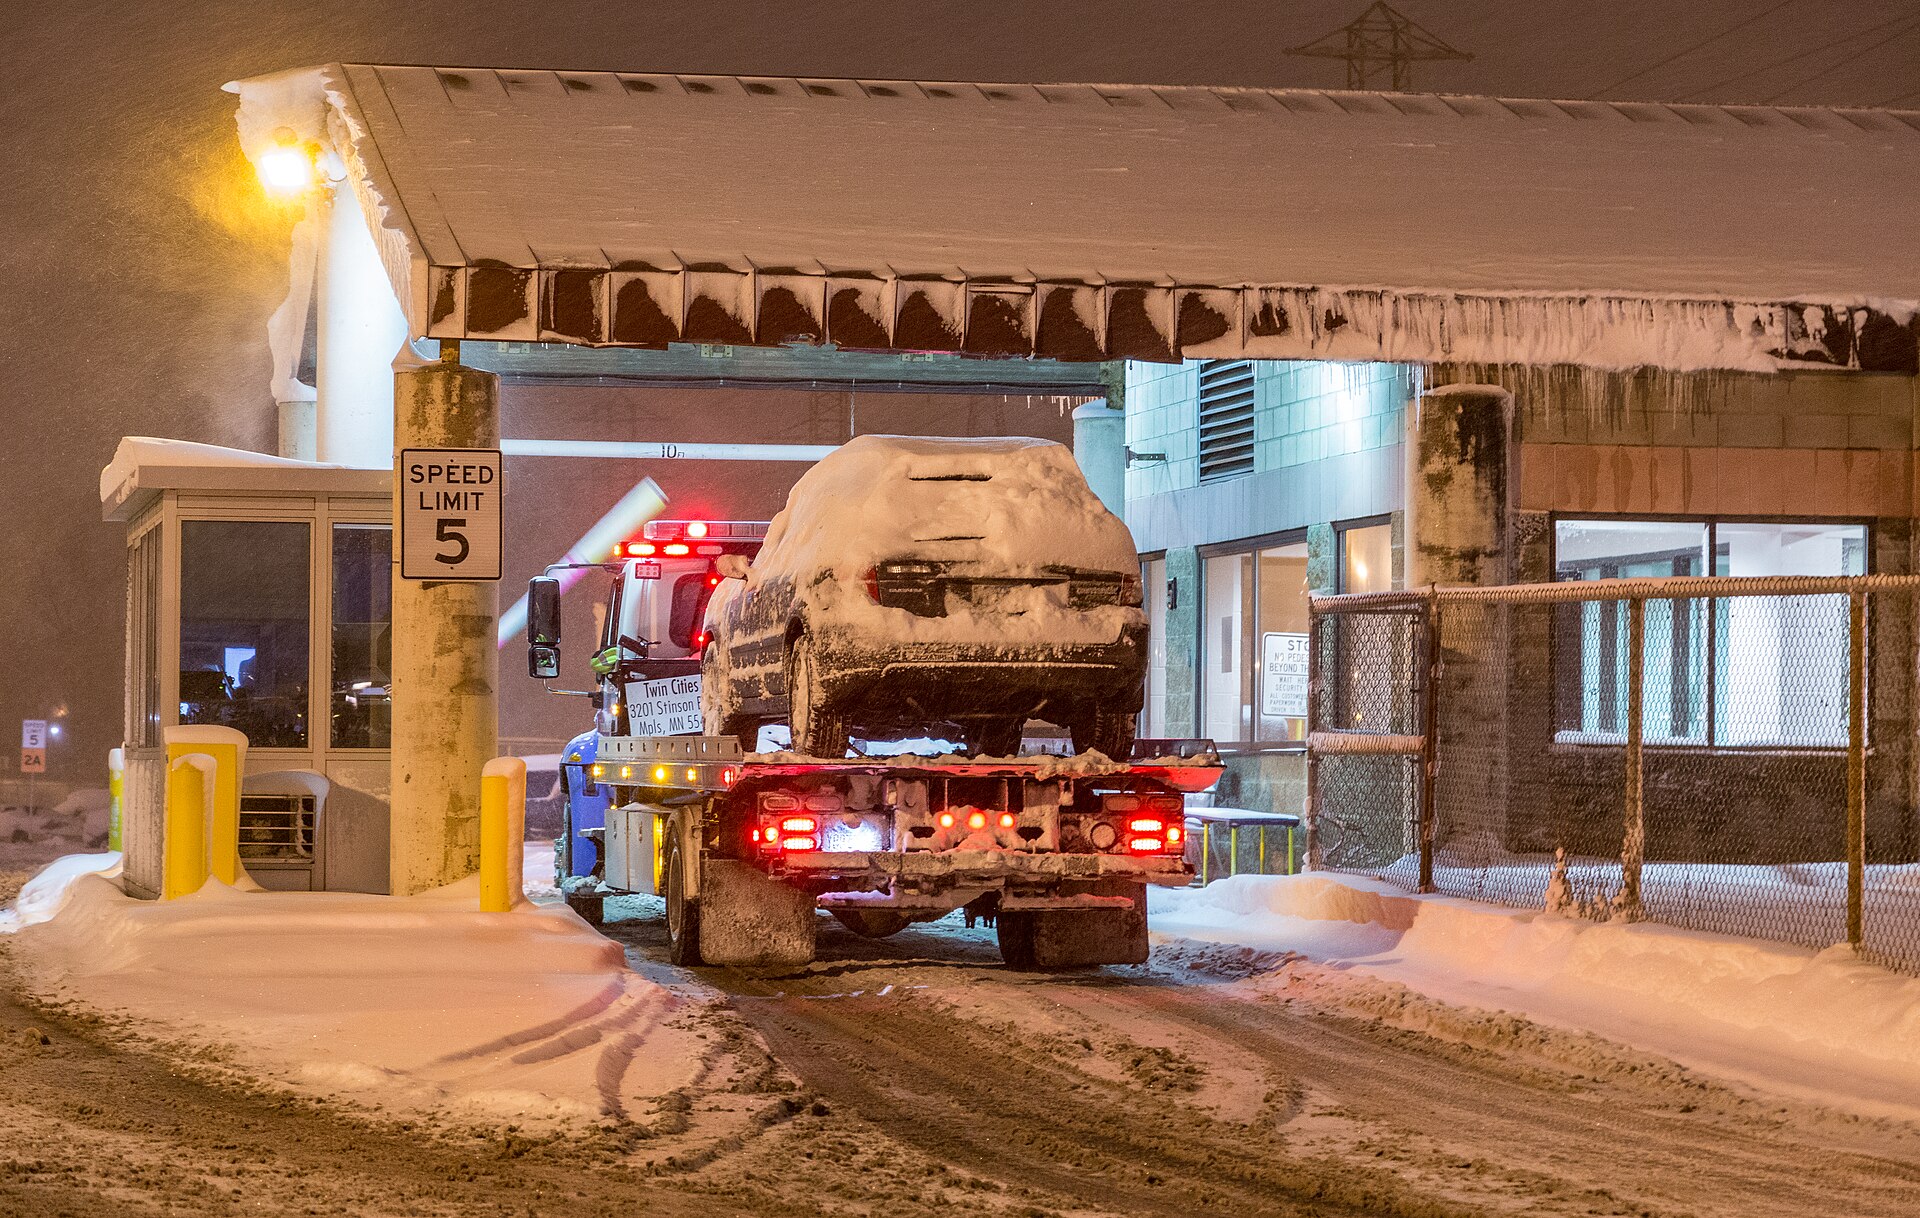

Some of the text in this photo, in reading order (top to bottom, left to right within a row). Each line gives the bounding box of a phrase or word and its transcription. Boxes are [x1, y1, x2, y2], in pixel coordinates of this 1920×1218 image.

[410, 464, 494, 484] SPEED
[420, 491, 484, 511] LIMIT
[434, 518, 470, 565] 5
[1287, 639, 1309, 651] STO
[1269, 662, 1309, 673] BEYOND TH
[1288, 653, 1309, 663] PEDES
[643, 678, 699, 698] Twin Cities
[629, 702, 654, 719] 3201
[656, 700, 694, 715] Stinson
[639, 714, 700, 736] Mpls, MN 55
[30, 735, 38, 745] 5
[25, 755, 41, 765] 2A
